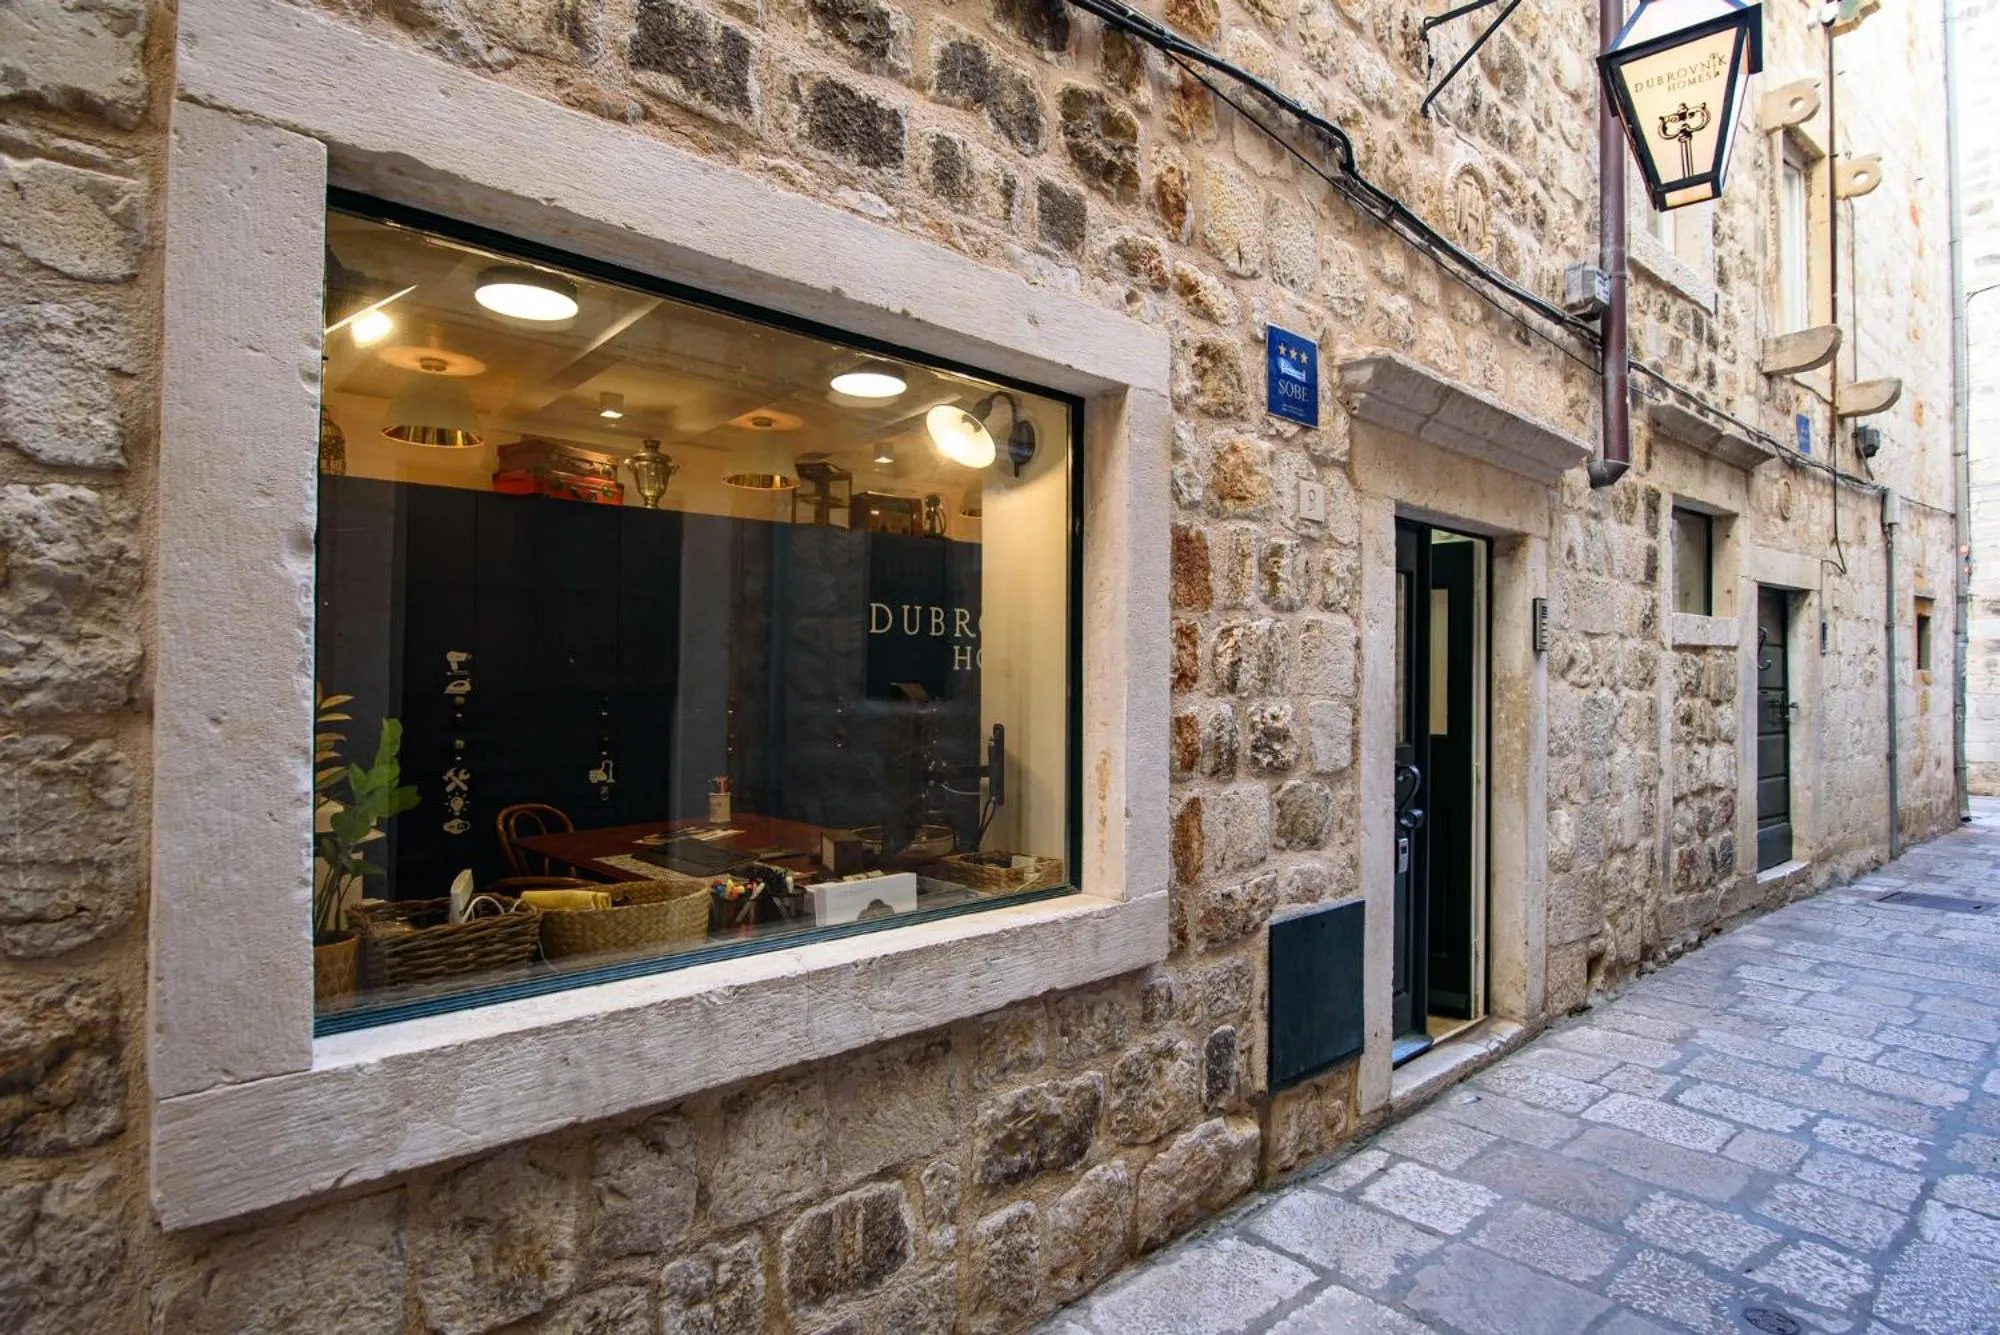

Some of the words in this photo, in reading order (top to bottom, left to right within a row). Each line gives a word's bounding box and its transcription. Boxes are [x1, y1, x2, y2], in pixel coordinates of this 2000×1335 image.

[1634, 53, 1726, 93] DUBROVNIK
[1668, 71, 1711, 93] HOMES
[1278, 379, 1309, 402] SOBE
[870, 602, 982, 638] DUBR
